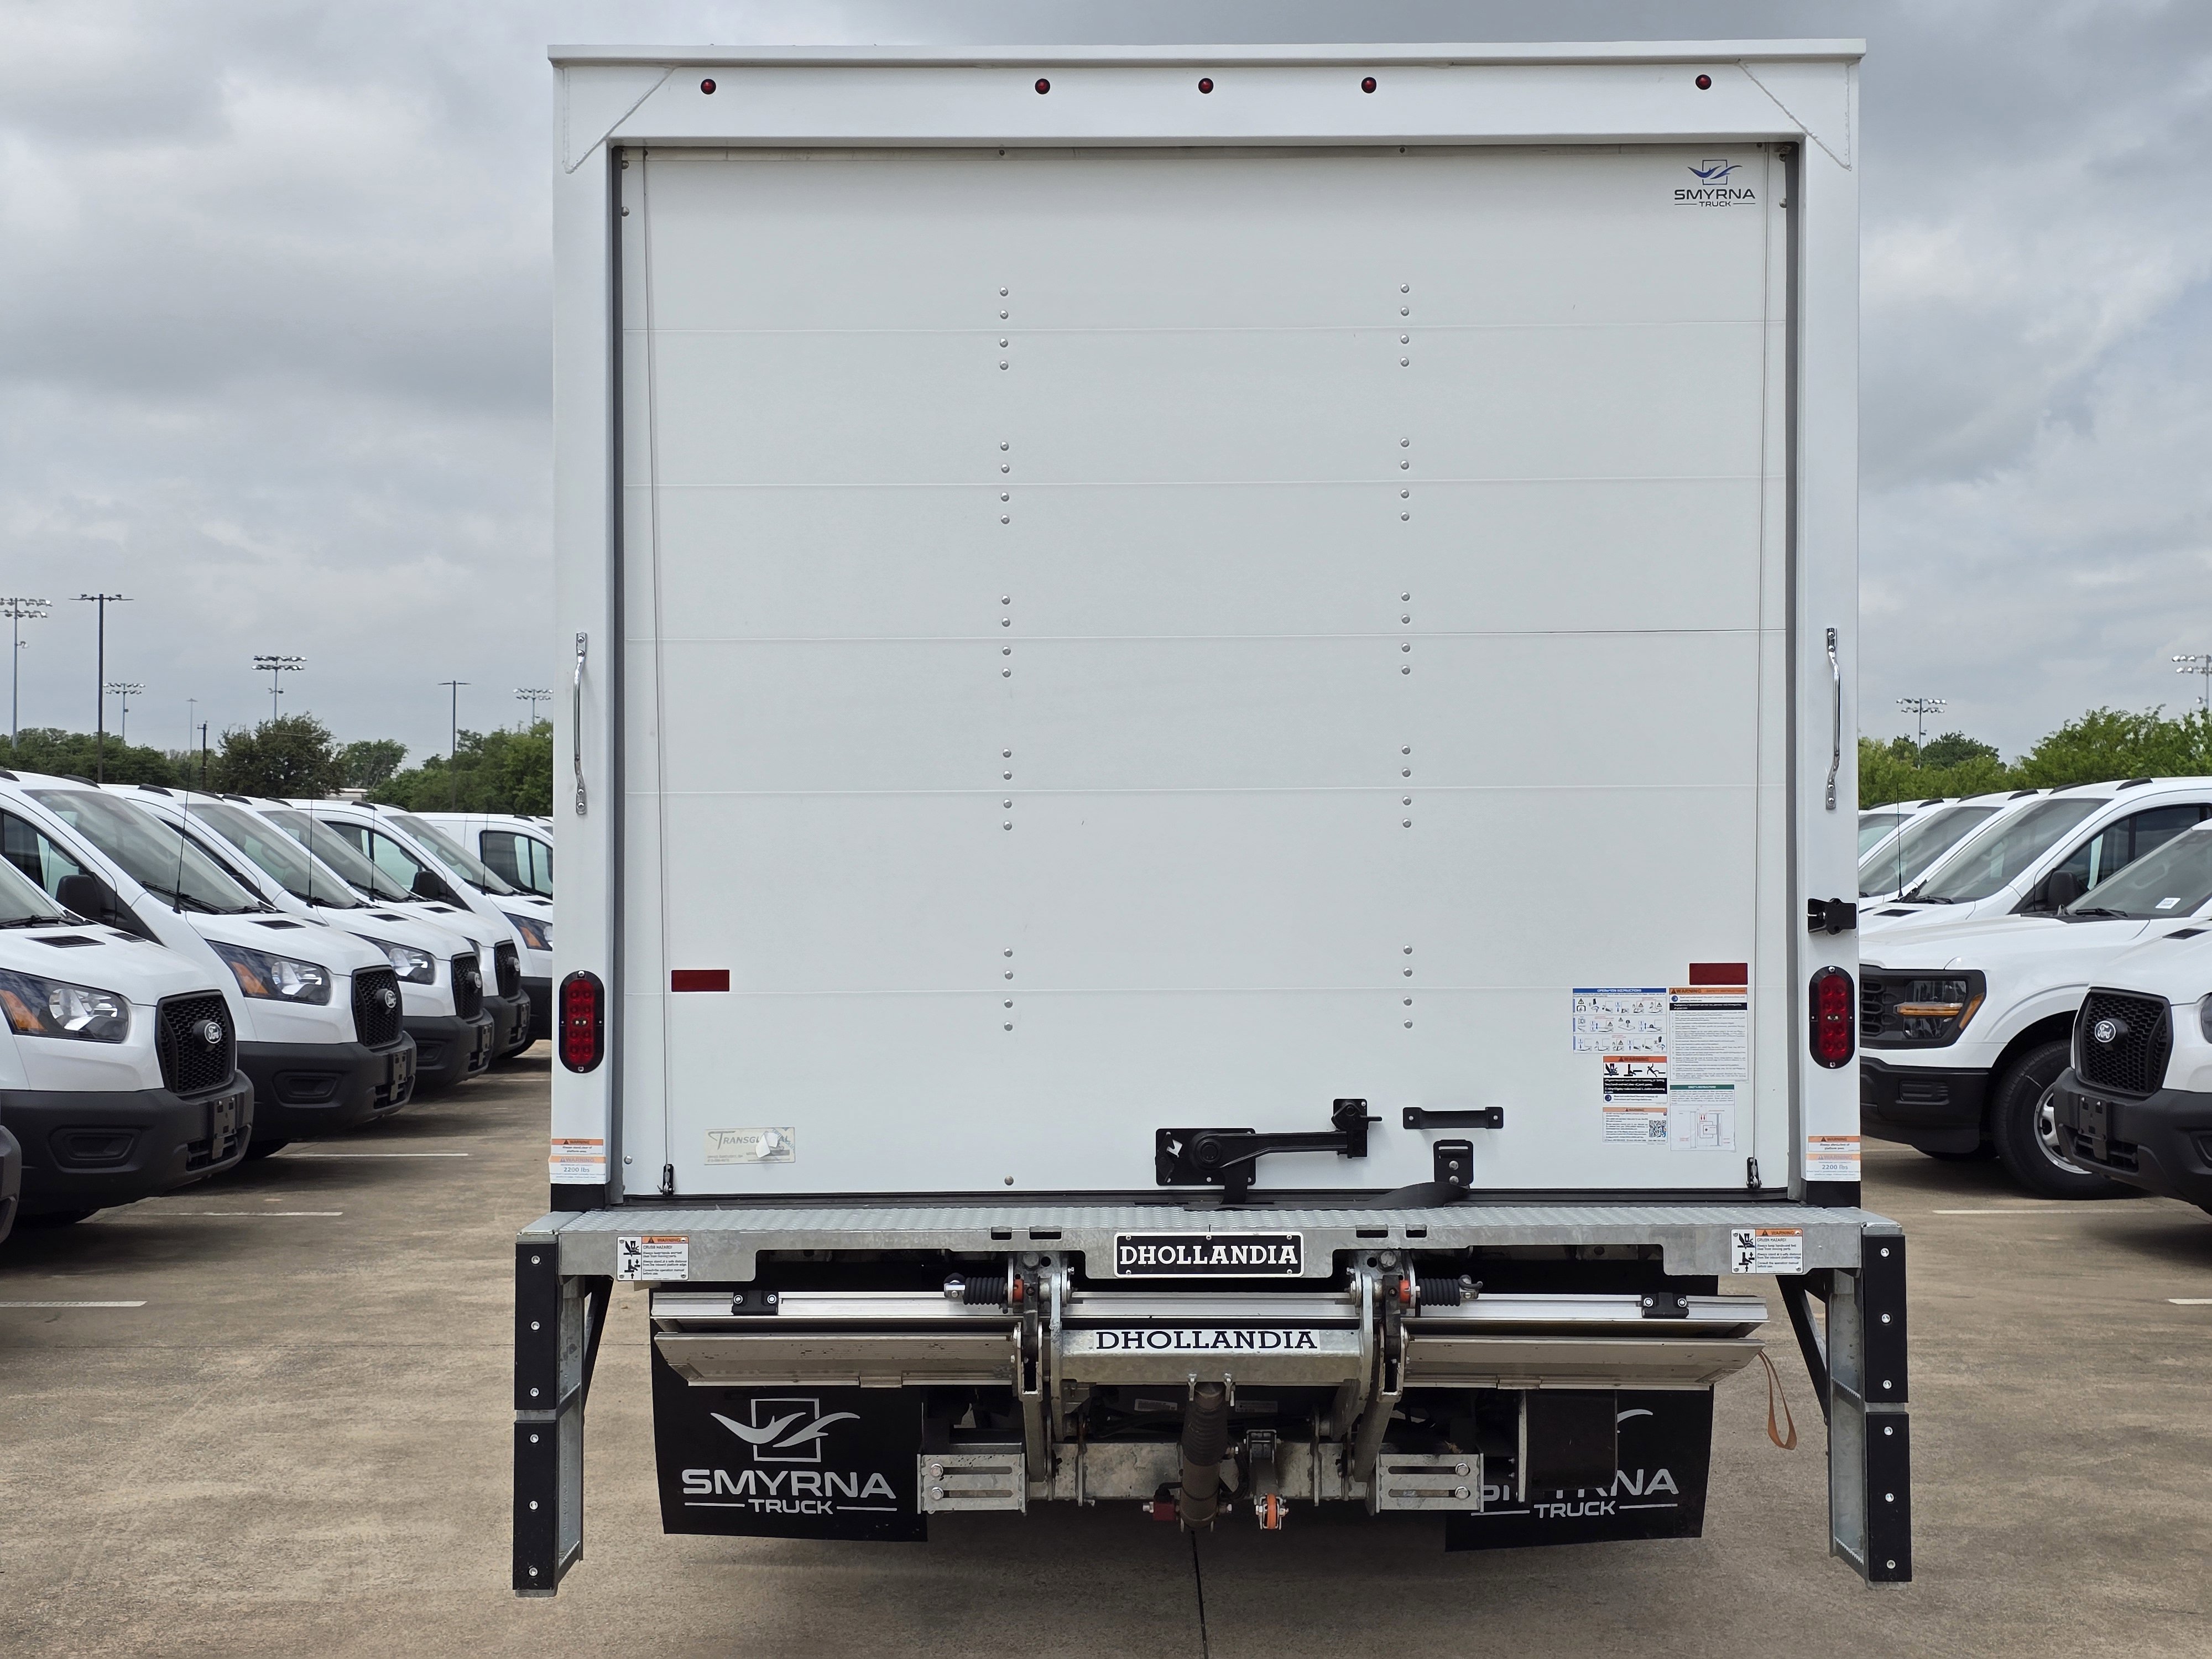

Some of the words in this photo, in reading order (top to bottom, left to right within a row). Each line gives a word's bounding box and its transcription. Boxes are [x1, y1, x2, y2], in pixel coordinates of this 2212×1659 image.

[1674, 189, 1756, 200] SMYRNA
[208, 1026, 220, 1040] Ford
[2098, 1024, 2112, 1039] Ford
[1120, 1245, 1298, 1265] DHOLLANDIA
[1096, 1331, 1317, 1349] DHOLLANDIA
[682, 1469, 896, 1499] SMYRNA
[748, 1499, 833, 1515] TRUCK
[1534, 1500, 1616, 1519] TRUCK
